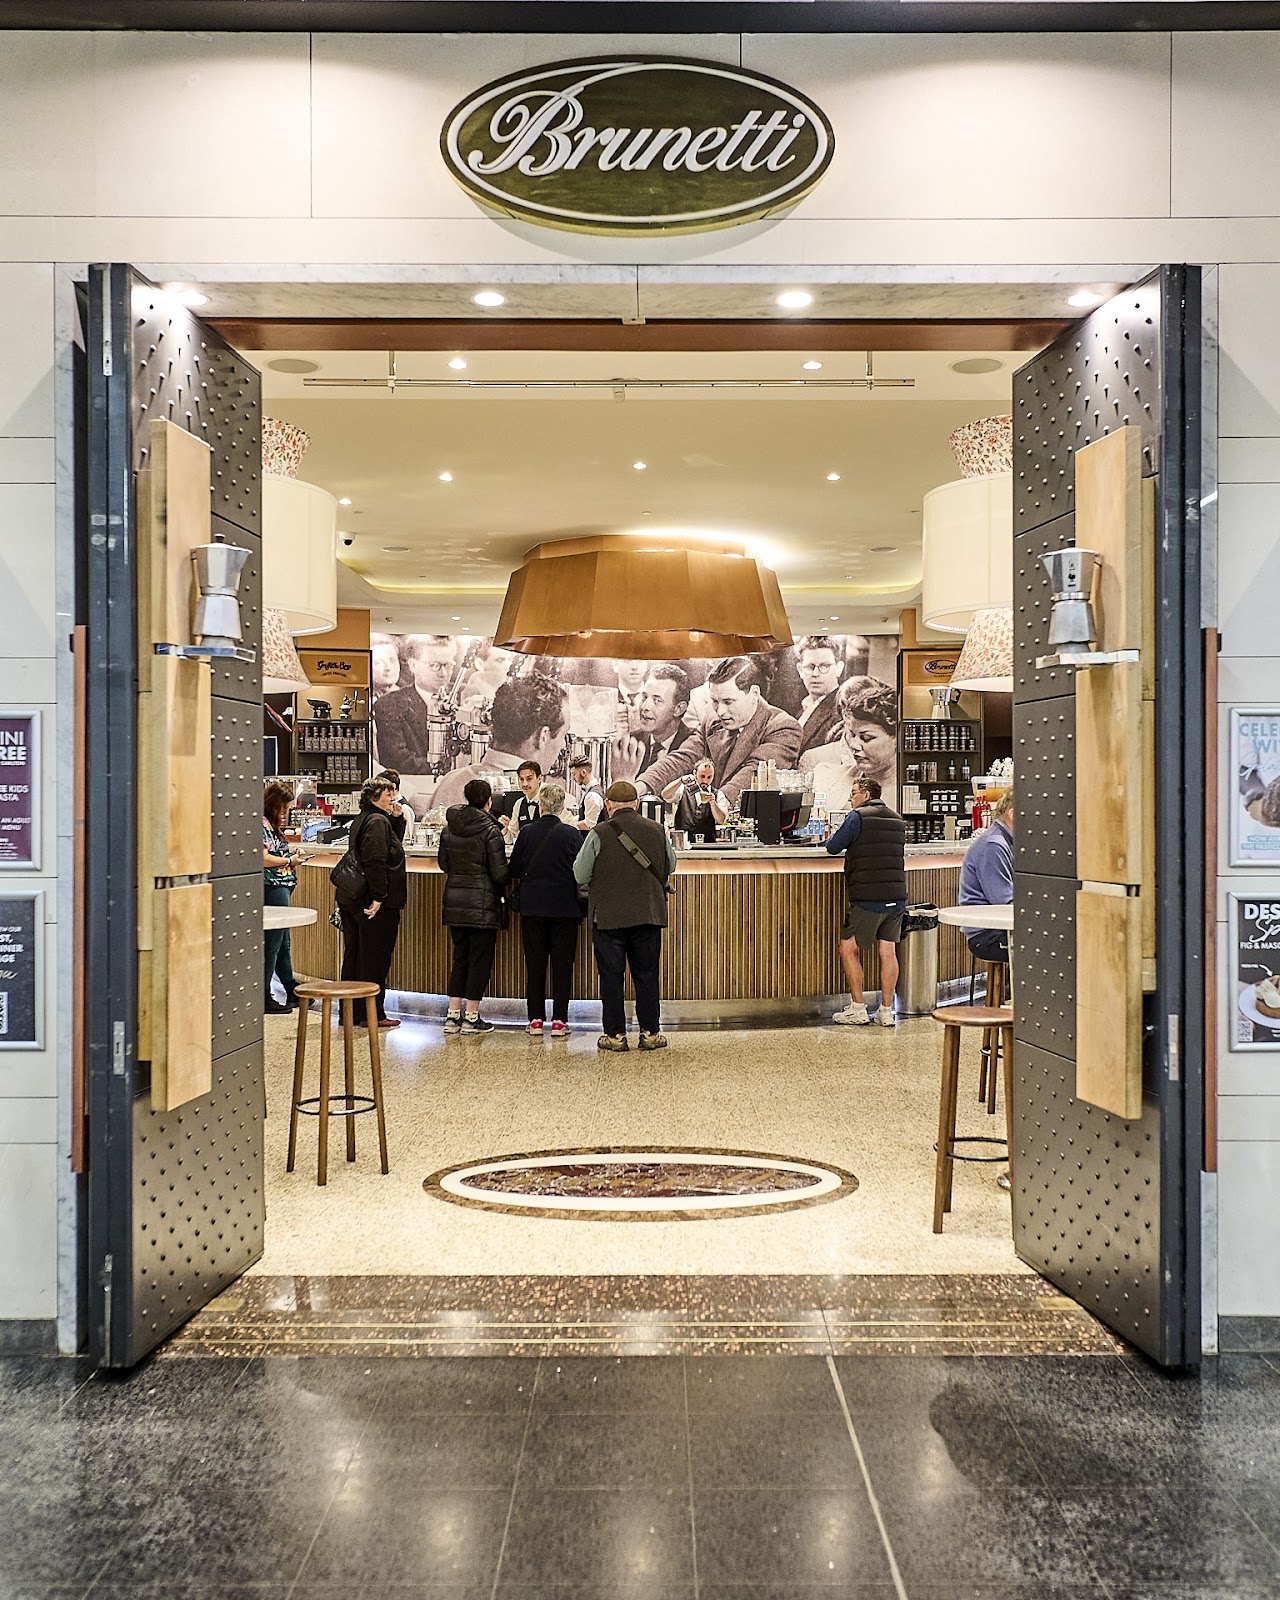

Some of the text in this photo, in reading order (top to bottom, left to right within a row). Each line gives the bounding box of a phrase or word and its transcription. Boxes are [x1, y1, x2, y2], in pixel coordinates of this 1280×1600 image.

[467, 85, 805, 178] Brunetti
[1239, 722, 1280, 737] CELE
[1253, 739, 1280, 753] WI
[8, 785, 29, 793] KIDS
[1244, 903, 1280, 920] DES
[1253, 942, 1260, 950] &
[0, 954, 16, 963] GE
